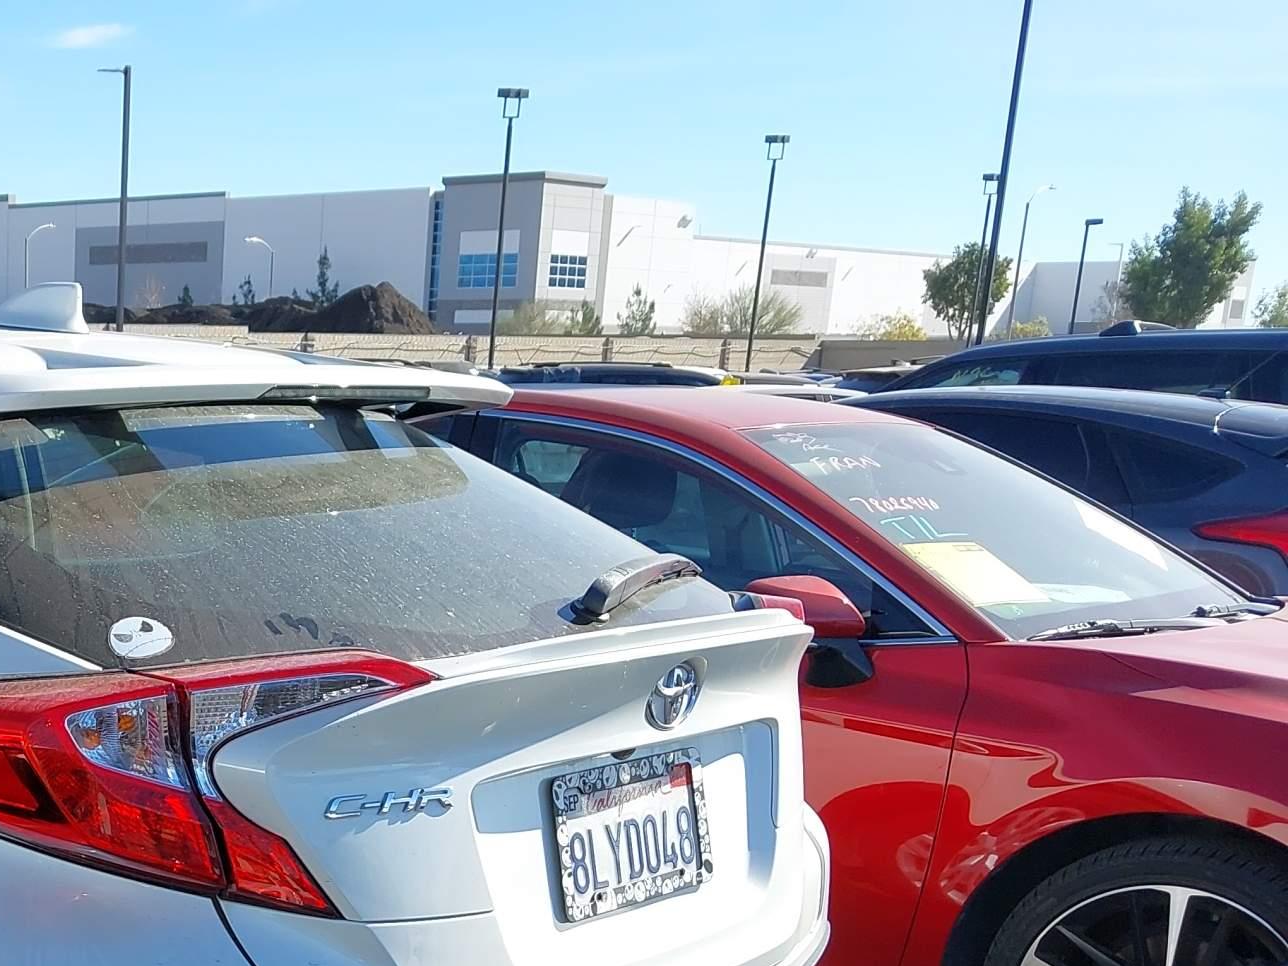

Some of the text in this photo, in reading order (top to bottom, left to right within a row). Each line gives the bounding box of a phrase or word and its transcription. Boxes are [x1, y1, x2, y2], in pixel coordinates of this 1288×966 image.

[324, 788, 454, 819] C-HR
[563, 793, 580, 812] SEP
[586, 781, 671, 815] California
[570, 806, 695, 894] 8LYD048
